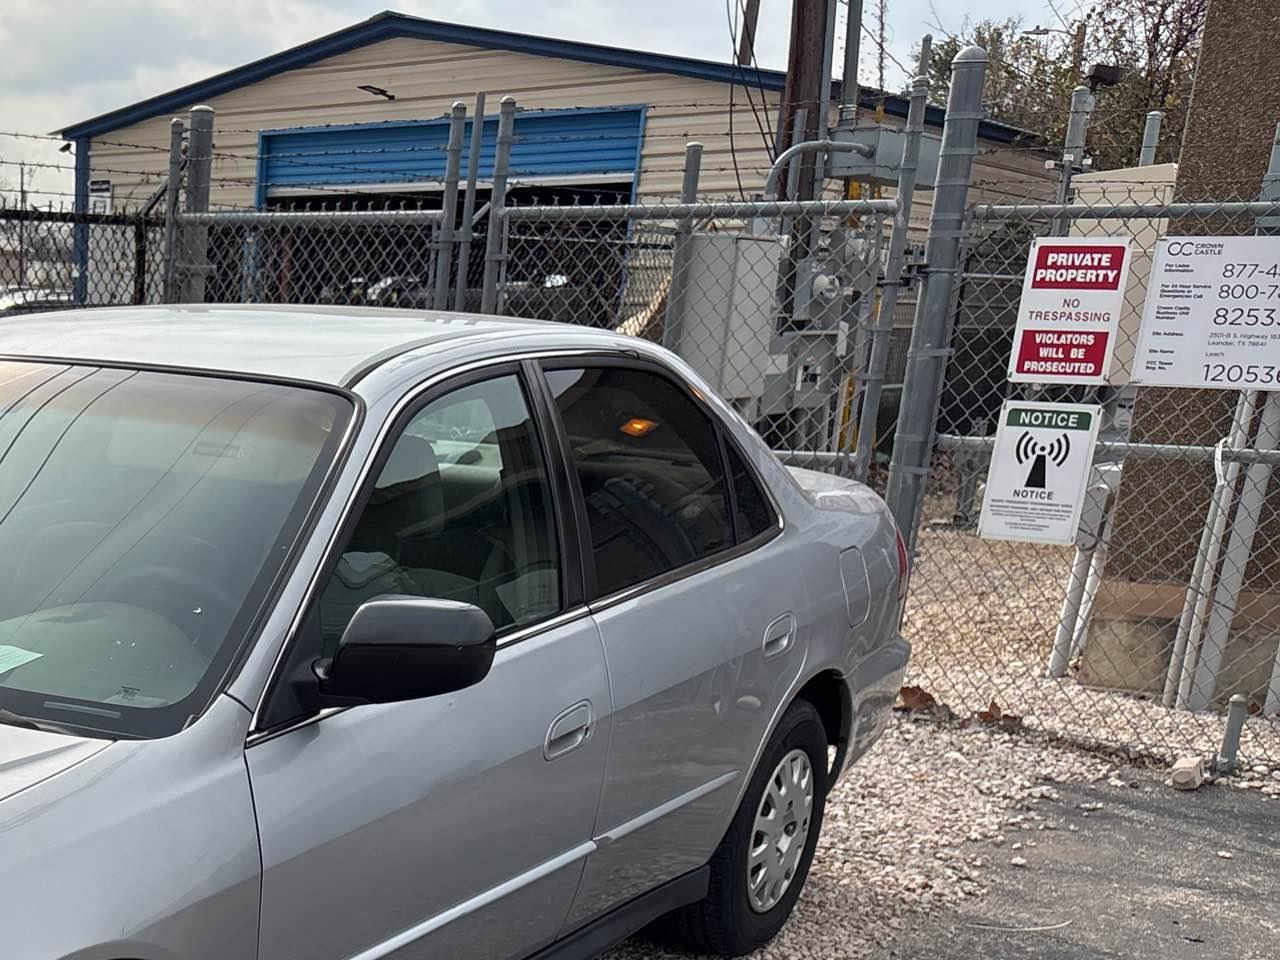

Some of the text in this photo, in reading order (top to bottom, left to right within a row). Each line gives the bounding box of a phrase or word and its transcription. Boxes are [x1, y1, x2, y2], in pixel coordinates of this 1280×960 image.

[1047, 253, 1112, 266] PRIVATE
[1035, 269, 1119, 283] PROPERTY
[1222, 263, 1280, 279] 877-4
[1218, 284, 1280, 299] 800-7
[1062, 298, 1080, 308] NO
[1029, 310, 1111, 322] TRESPASSING
[1213, 307, 1280, 327] 8253
[1035, 333, 1095, 345] VIOLATORS
[1039, 347, 1086, 359] WILL BE
[1023, 361, 1095, 373] PROSECUTED
[1020, 412, 1079, 427] NOTICE
[1013, 489, 1054, 500] NOTICE
